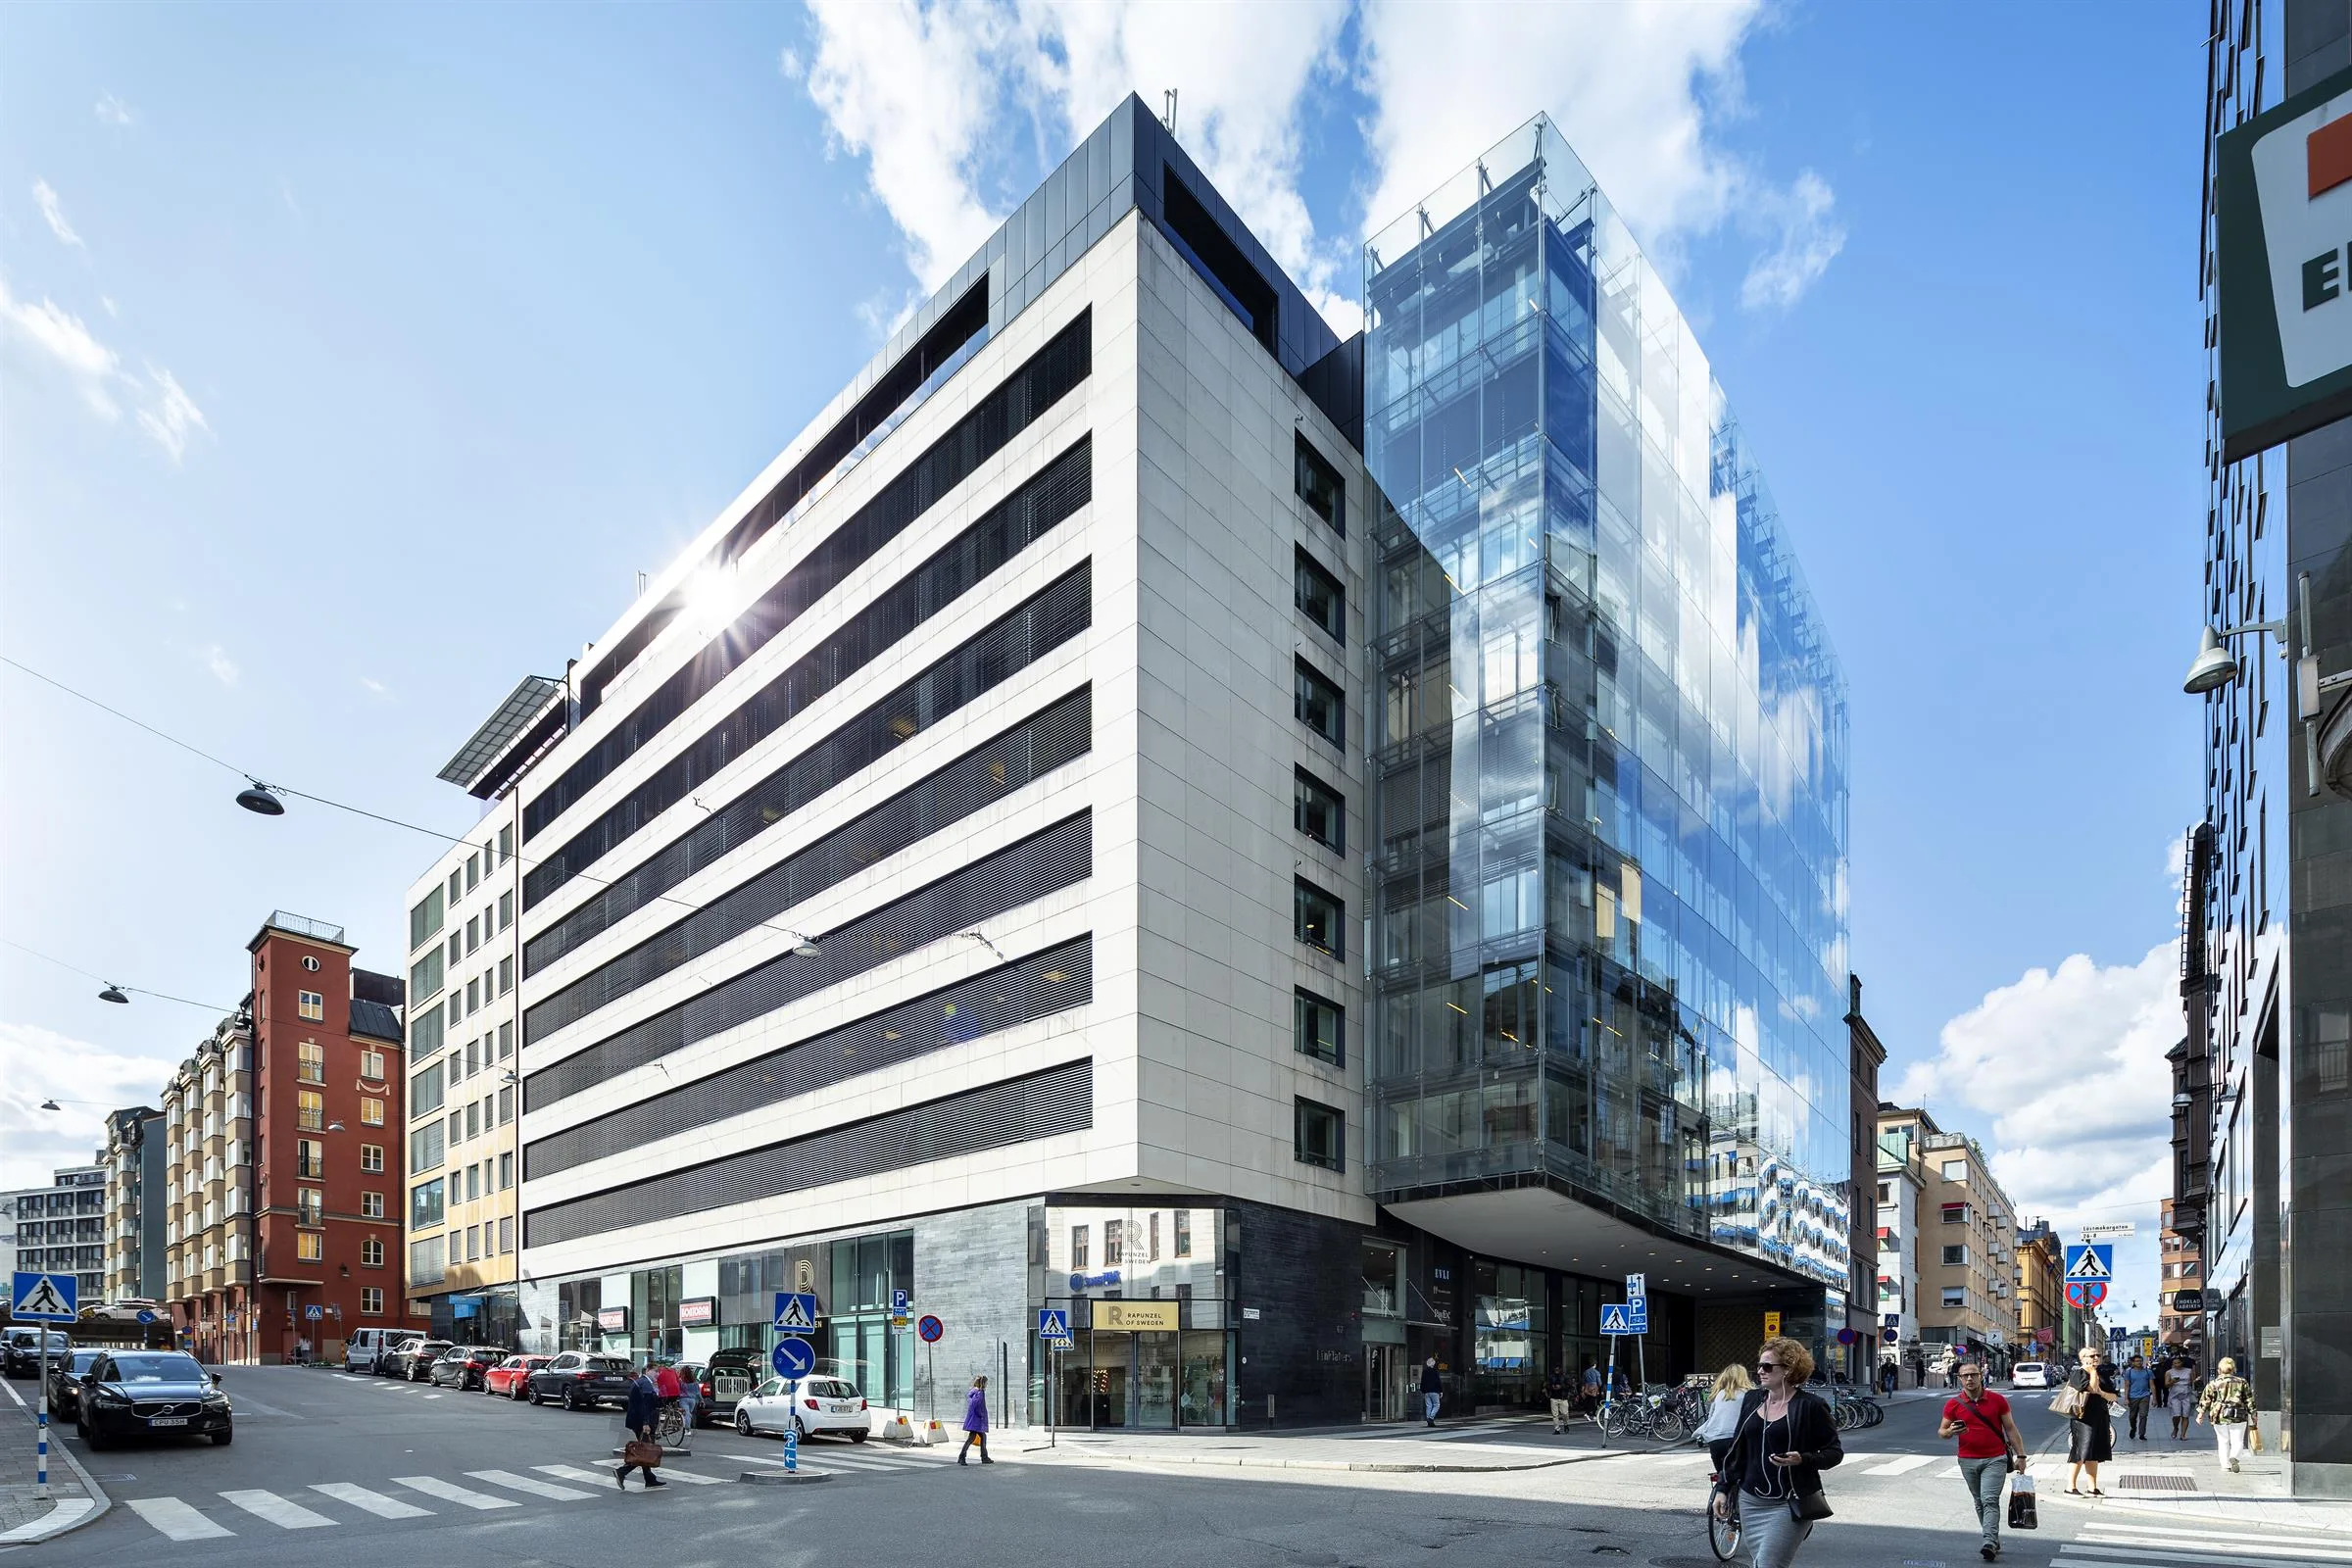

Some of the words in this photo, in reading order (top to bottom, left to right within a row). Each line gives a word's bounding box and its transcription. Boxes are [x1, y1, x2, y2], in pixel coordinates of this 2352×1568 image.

[1435, 1268, 1449, 1280] EVLI
[896, 1292, 905, 1306] P
[1632, 1298, 1642, 1314] P
[1108, 1305, 1123, 1326] R
[787, 1435, 795, 1447] P
